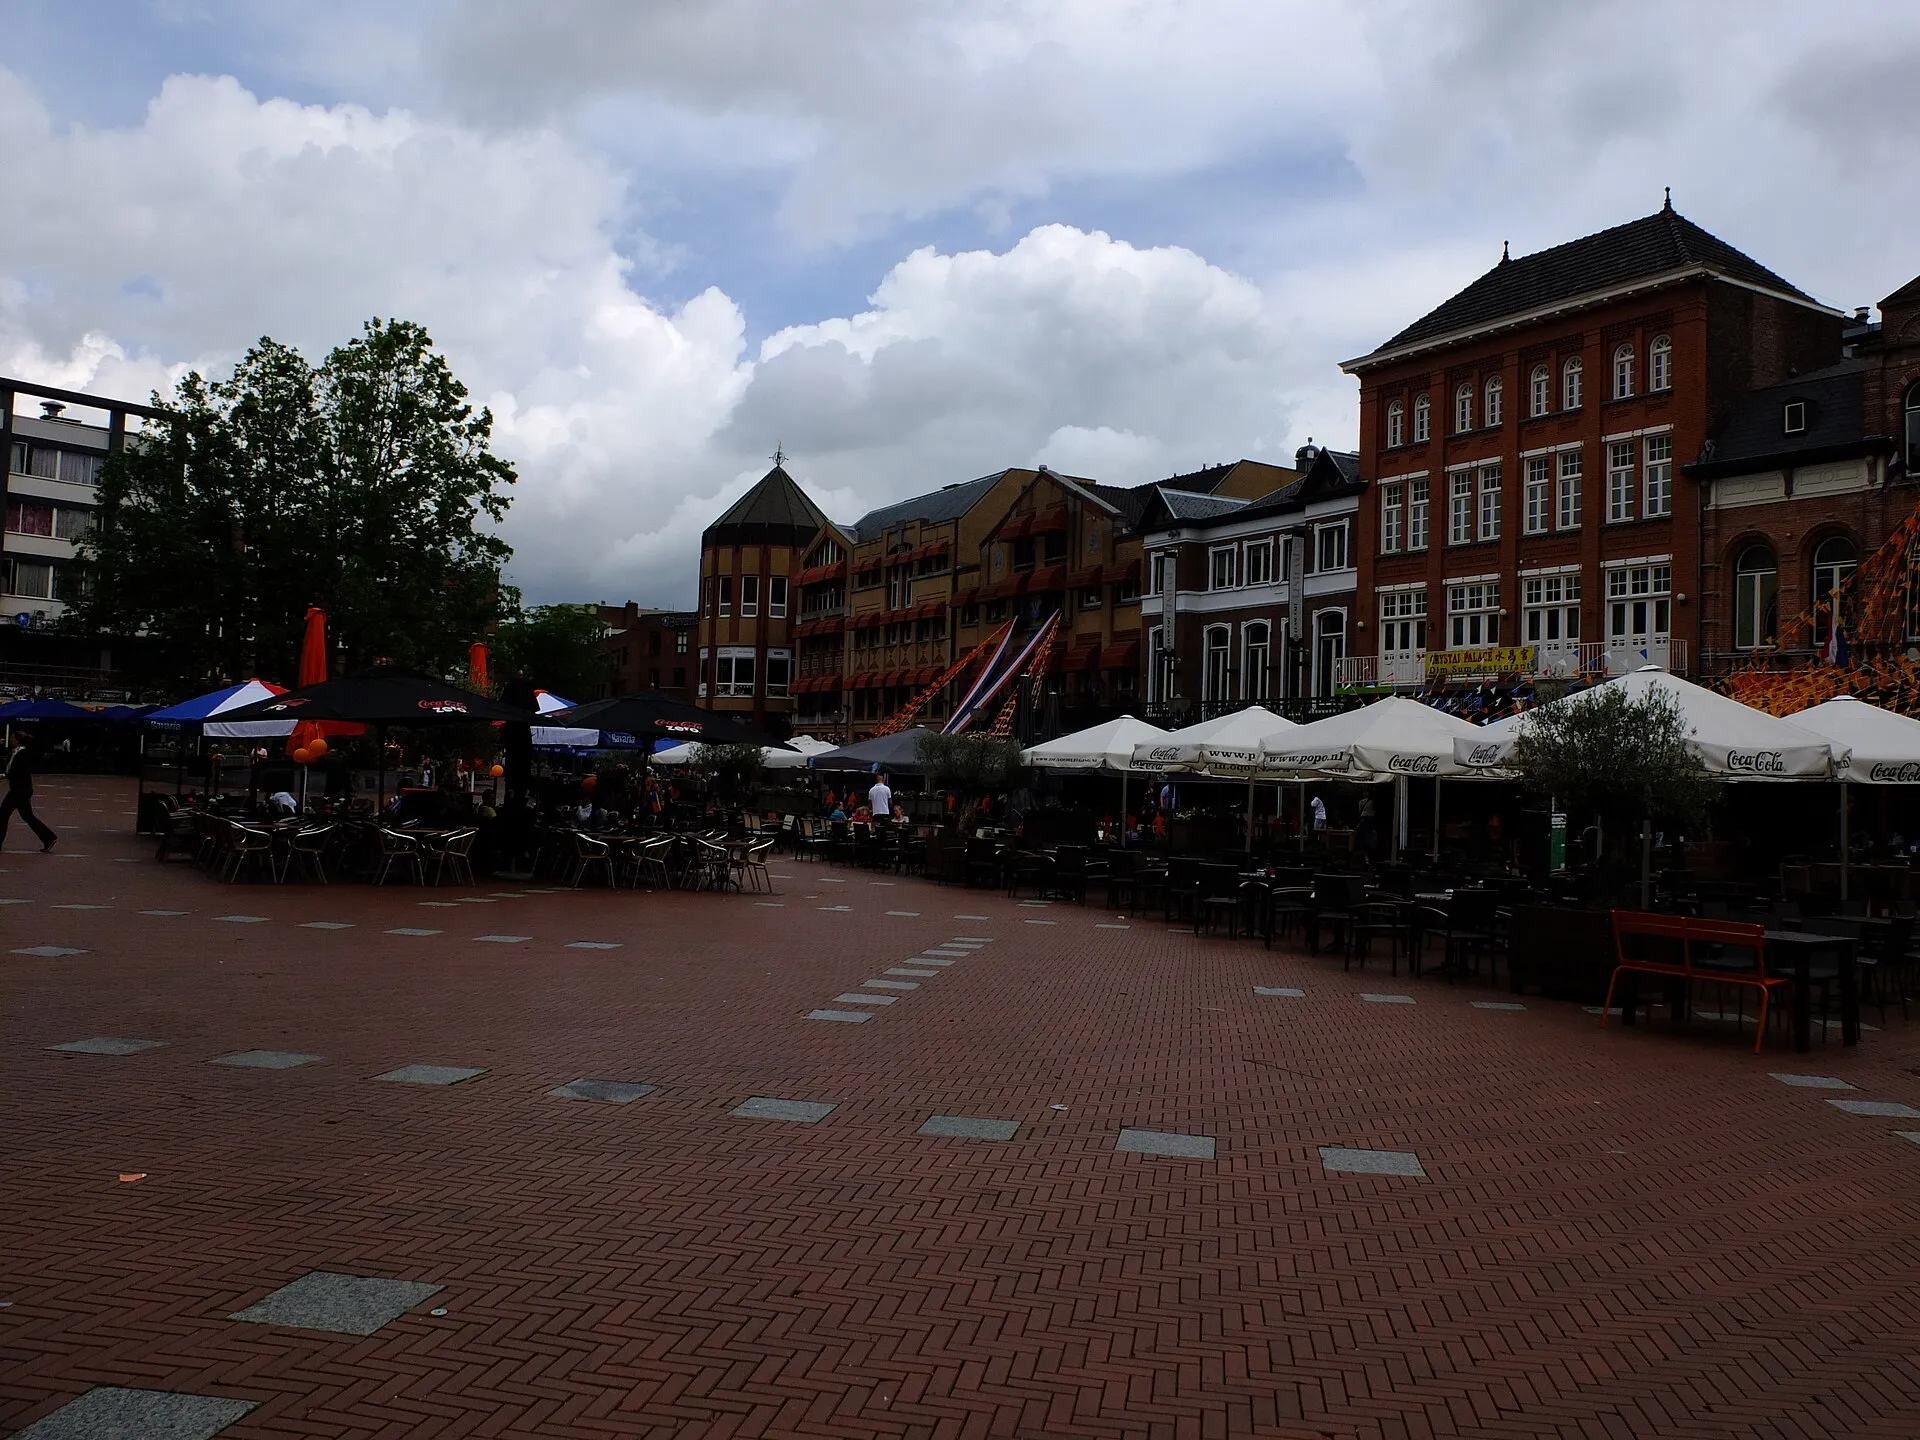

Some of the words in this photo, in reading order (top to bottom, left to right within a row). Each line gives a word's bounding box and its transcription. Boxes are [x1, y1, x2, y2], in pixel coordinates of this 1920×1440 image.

[1464, 651, 1493, 662] PALACE
[1429, 666, 1448, 674] Dim
[1452, 665, 1473, 673] Sum
[150, 721, 181, 731] Bavaria
[611, 734, 636, 744] Bavaria
[1150, 748, 1180, 760] Coca-Cola
[1269, 752, 1344, 764] www.popo.nl
[1468, 744, 1501, 763] Coca-Cola
[1388, 755, 1439, 772] Coca-Cola
[1727, 750, 1783, 771] Coca-Cola
